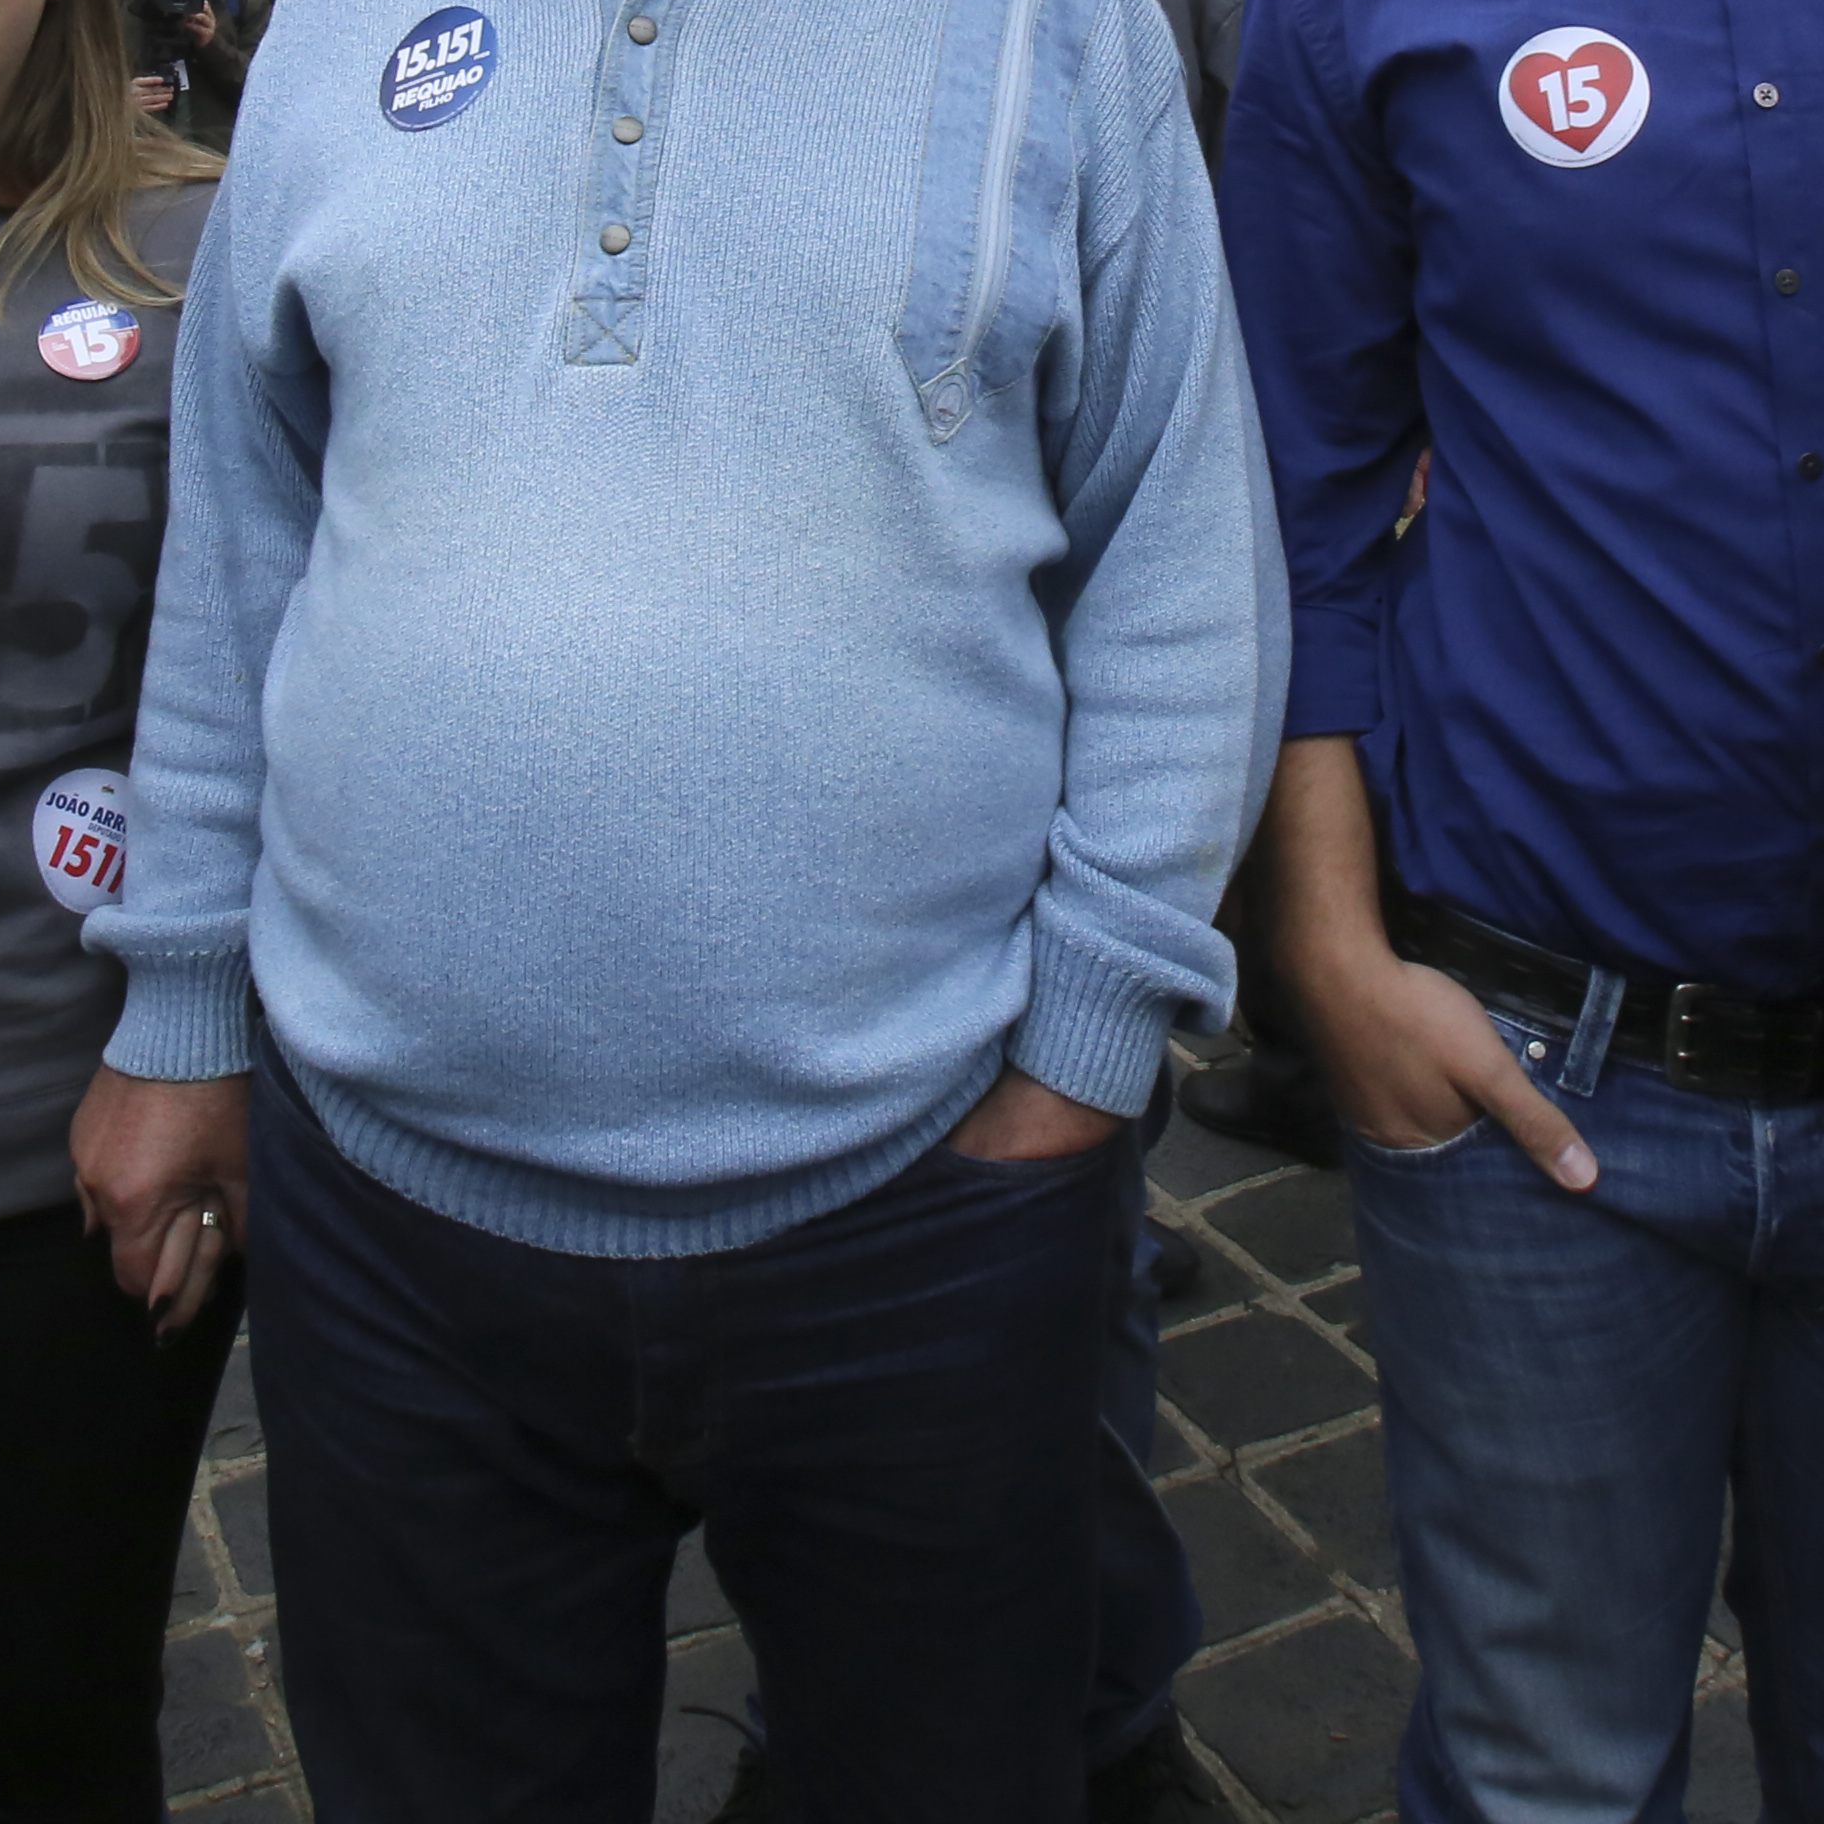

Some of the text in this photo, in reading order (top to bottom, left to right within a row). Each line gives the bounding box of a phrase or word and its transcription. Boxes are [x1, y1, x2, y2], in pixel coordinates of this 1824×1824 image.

[395, 18, 484, 83] 15.151
[418, 92, 454, 112] FILHO
[1538, 64, 1608, 133] 15
[62, 318, 120, 368] 15
[45, 791, 126, 834] JOÃO ARR
